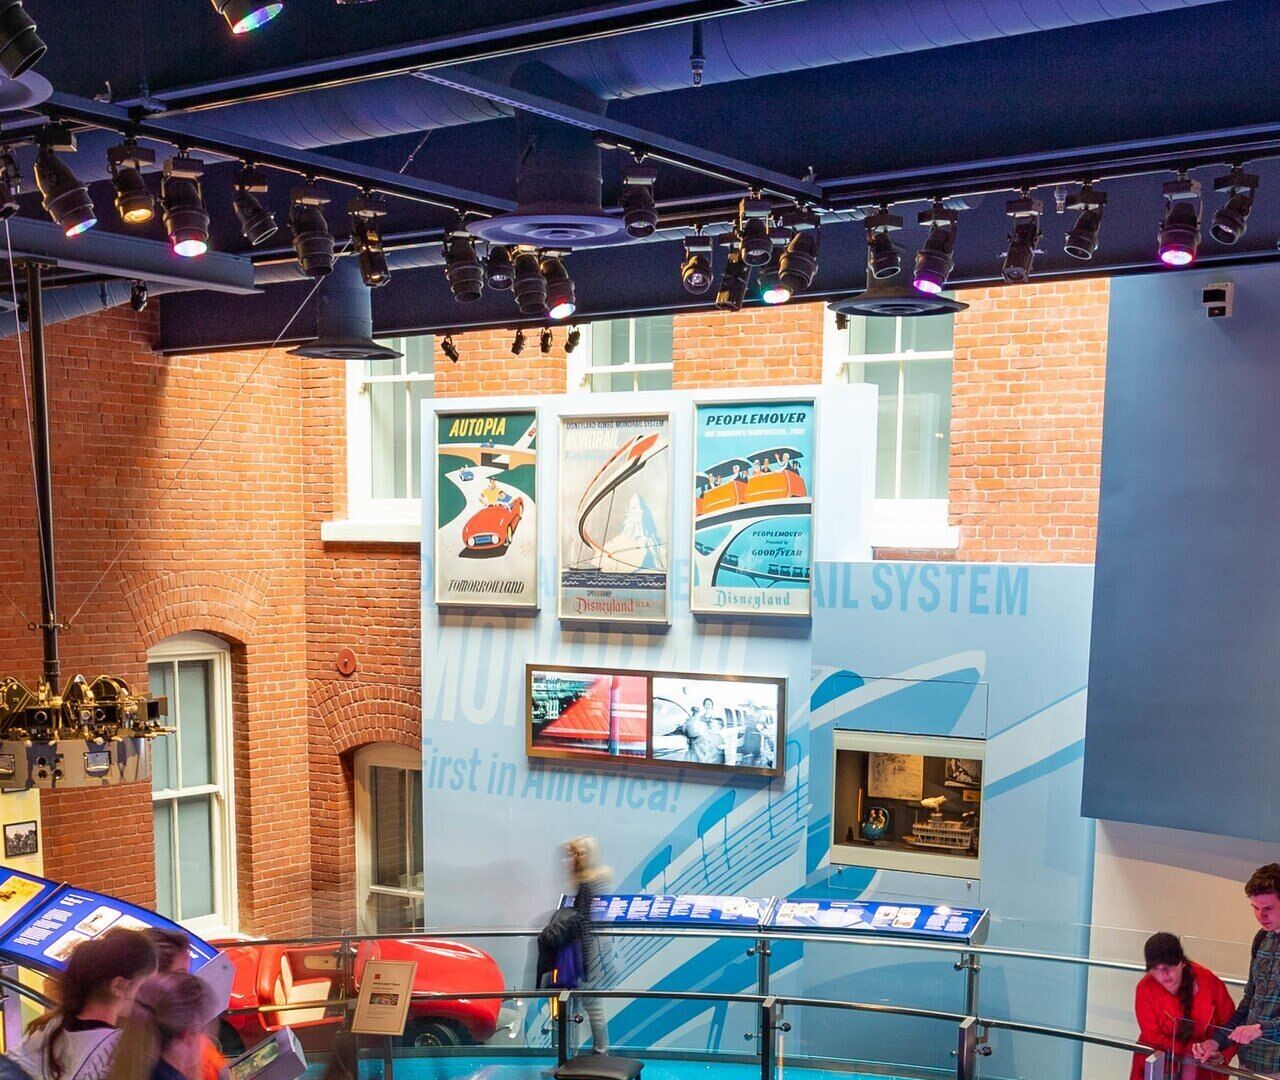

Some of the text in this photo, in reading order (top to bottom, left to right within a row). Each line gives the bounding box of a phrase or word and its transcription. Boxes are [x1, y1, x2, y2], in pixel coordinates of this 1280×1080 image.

[448, 417, 507, 437] AUTOPIA
[706, 412, 807, 426] PEOPLEMOVER
[448, 579, 525, 594] TOMORROWLAND
[871, 562, 1029, 616] SYSTEM
[575, 597, 634, 615] Disneyland
[713, 590, 790, 609] Disneyland
[487, 752, 518, 797] in
[520, 760, 683, 813] America!
